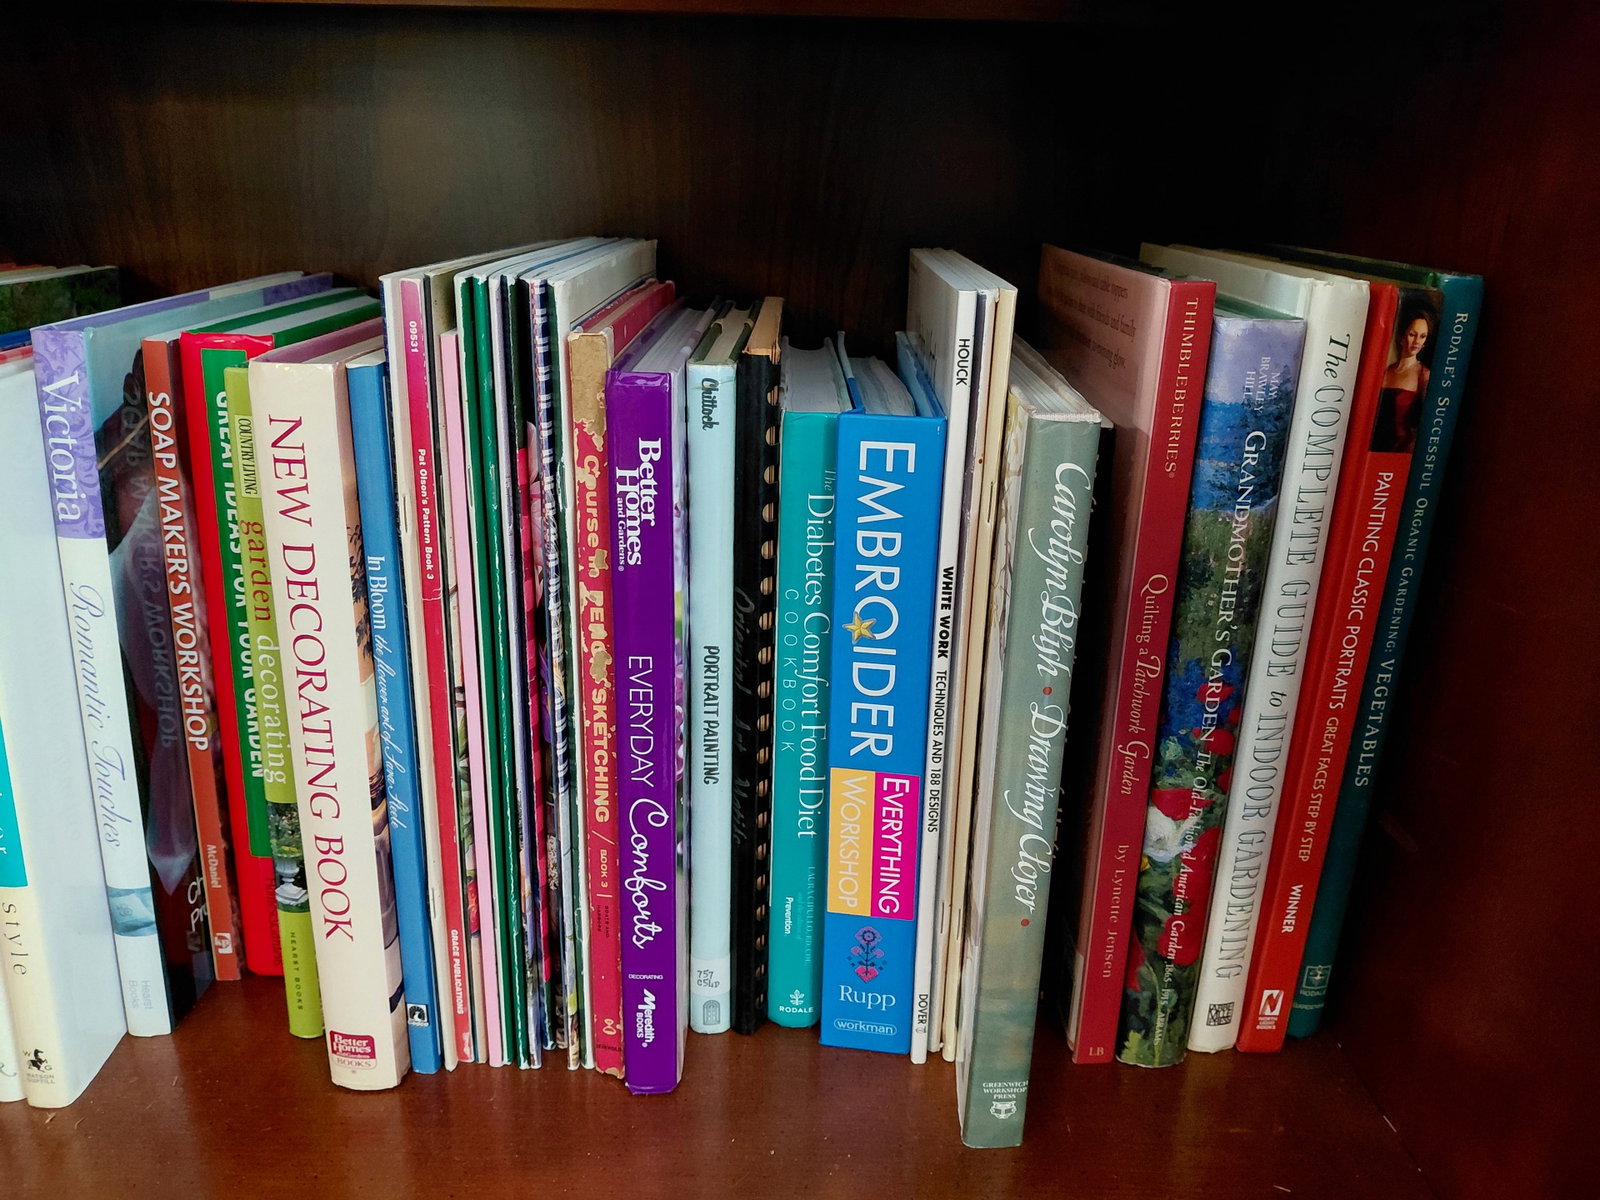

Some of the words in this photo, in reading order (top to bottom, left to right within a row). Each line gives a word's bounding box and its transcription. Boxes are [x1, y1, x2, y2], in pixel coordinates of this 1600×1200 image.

[409, 320, 419, 353] 09531
[956, 338, 970, 386] HOUCK
[1323, 333, 1351, 379] The
[1441, 312, 1469, 388] RODALE'S
[701, 377, 719, 431] Chittock
[1242, 371, 1256, 399] HILL
[1254, 356, 1271, 414] BRAWLEY
[1269, 372, 1281, 400] MAY
[42, 370, 87, 522] Victoria
[149, 391, 177, 470] SOAP
[238, 418, 255, 463] COUNTRY
[418, 449, 427, 466] Pat
[1419, 396, 1450, 491] SUCCESSFUL
[242, 463, 257, 495] LIVING
[269, 414, 313, 527] NEW
[419, 469, 428, 505] Olson's
[638, 437, 662, 527] Better
[1285, 384, 1346, 567] COMPLETE
[422, 507, 431, 544] Pattern
[616, 466, 642, 565] Homes
[617, 497, 625, 518] and
[1028, 462, 1091, 593] Carolyn
[1362, 472, 1394, 552] PAINTING
[1404, 498, 1428, 561] ORGANIC
[157, 476, 191, 595] MAKER'S
[367, 555, 386, 571] In
[425, 547, 433, 574] Book
[805, 493, 835, 606] Diabetes
[1215, 431, 1267, 641] GRANDMOTHER'S
[368, 575, 387, 630] Bloom
[850, 440, 916, 757] EMBROIDER
[940, 566, 954, 611] WHITE
[1136, 573, 1169, 643] Quilting
[1347, 557, 1375, 620] CLASSIC
[240, 519, 272, 621] garden
[256, 635, 291, 784] decorating
[374, 634, 393, 655] the
[938, 615, 951, 659] WORK
[1032, 590, 1078, 679] Blish
[1139, 647, 1149, 656] a
[1266, 579, 1312, 679] GUIDE
[173, 603, 209, 751] WORKSHOP
[282, 543, 341, 820] DECORATING
[704, 646, 720, 717] PORTRAIT
[795, 613, 831, 718] Comfort
[1329, 625, 1361, 710] PORTRAITS
[70, 582, 111, 729] Romantic
[92, 740, 132, 847] Touches
[628, 656, 654, 787] EVERYDAY
[932, 669, 948, 737] TECHNIQUES
[1129, 655, 1161, 734] Patchwork
[1201, 648, 1233, 742] GARDEN
[1268, 690, 1287, 708] to
[1320, 717, 1339, 754] GREAT
[1354, 658, 1396, 787] VEGETABLES
[592, 688, 609, 823] SKETCHING
[704, 720, 720, 785] PAINTING
[800, 724, 827, 781] Food
[930, 767, 941, 787] 188
[931, 739, 943, 764] AND
[1004, 701, 1068, 830] Drawing
[1118, 740, 1150, 795] Garden
[1195, 751, 1211, 772] The
[1242, 712, 1288, 821] INDOOR
[1312, 757, 1331, 791] FACES
[797, 789, 825, 839] Diet
[927, 788, 940, 833] DESIGNS
[1303, 821, 1317, 835] BY
[1307, 793, 1324, 819] STEP
[206, 844, 222, 889] McDaniel
[600, 849, 608, 881] BOOK
[838, 776, 868, 908] WORKSHOP
[878, 777, 910, 915] EVERYTHING
[1115, 844, 1130, 863] by
[1298, 836, 1313, 862] STEP
[314, 834, 354, 942] BOOK
[625, 798, 669, 950] Comforts
[1011, 833, 1052, 914] Closer
[1110, 869, 1125, 924] Lynette
[1173, 862, 1195, 917] American
[1215, 828, 1267, 980] GARDENING
[1281, 884, 1304, 934] WINNER
[2, 902, 28, 975] style
[451, 929, 460, 957] GRACE
[1102, 928, 1118, 979] Jensen
[453, 958, 465, 1015] PUBLICATIONS
[697, 969, 714, 979] 757
[839, 985, 896, 1010] Rupp
[636, 1012, 644, 1038] BOOKS
[638, 988, 656, 1043] Meredith
[779, 1005, 814, 1013] RODALE
[837, 1020, 893, 1035] workman
[917, 994, 928, 1024] DOVER
[333, 1034, 369, 1047] Better
[333, 1042, 371, 1053] Homes
[337, 1058, 372, 1067] BOOKS
